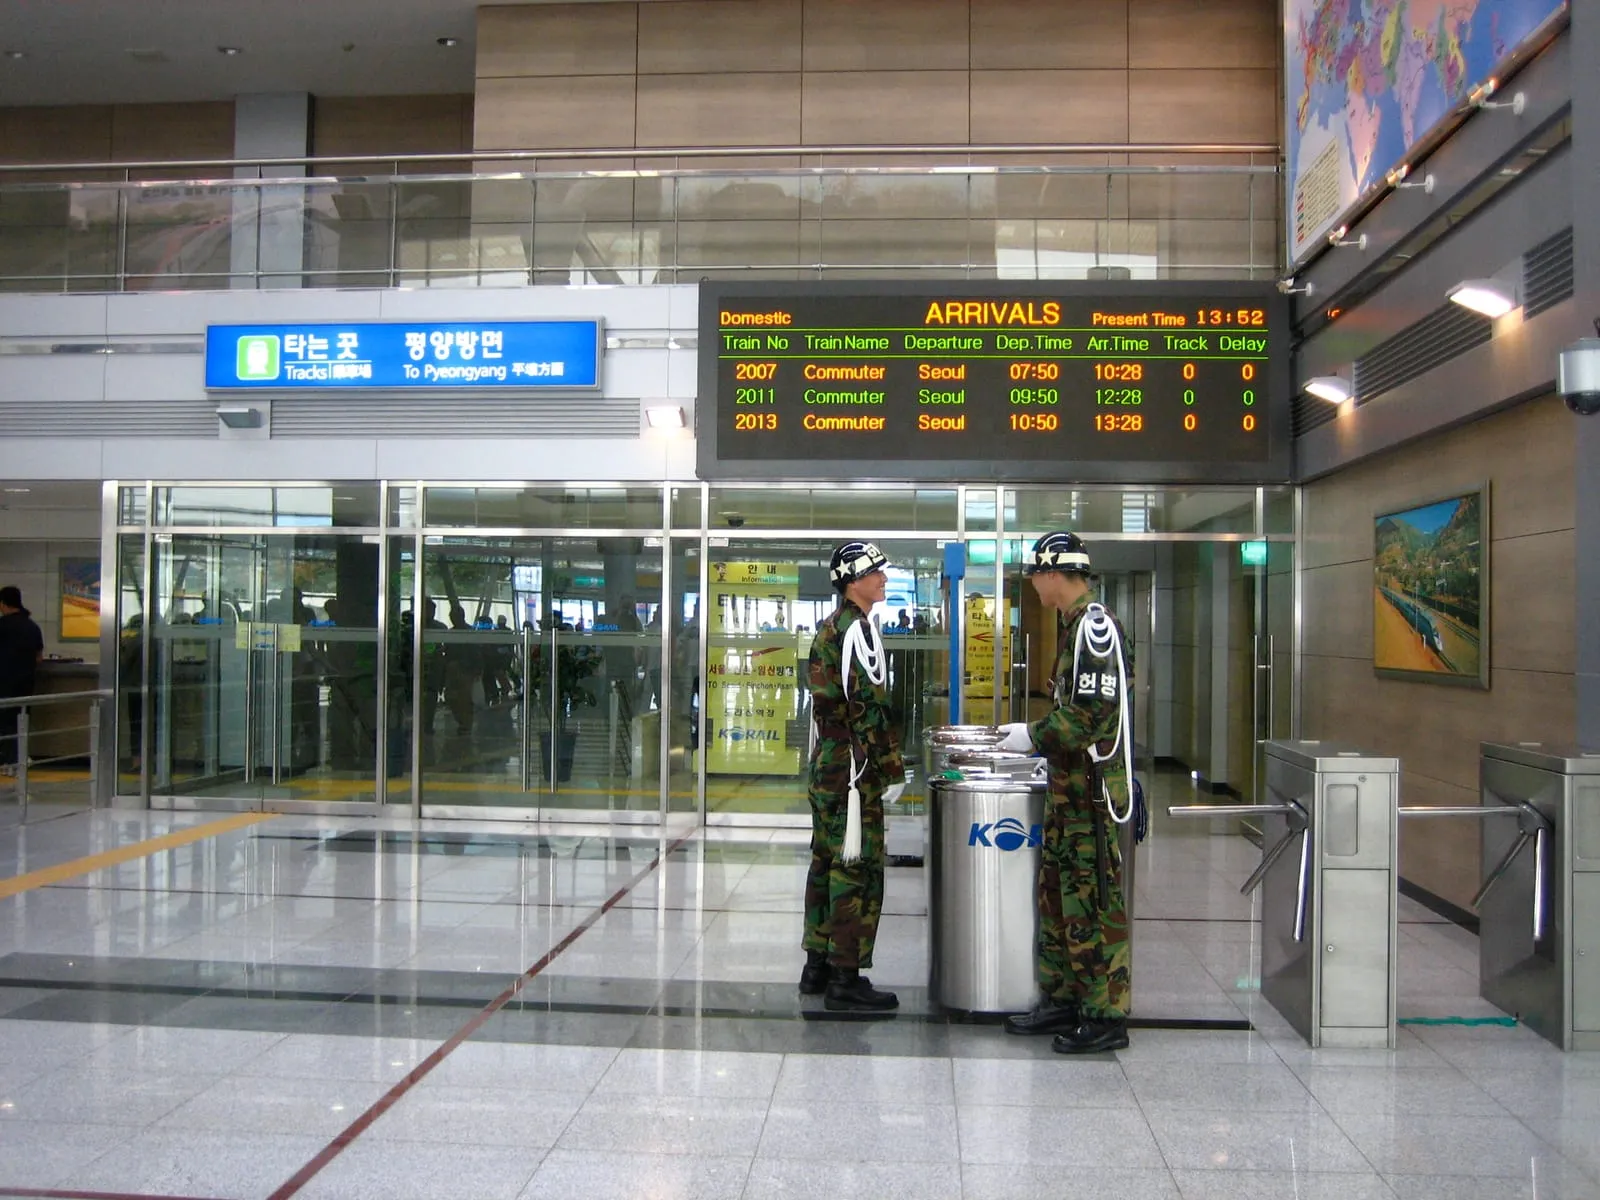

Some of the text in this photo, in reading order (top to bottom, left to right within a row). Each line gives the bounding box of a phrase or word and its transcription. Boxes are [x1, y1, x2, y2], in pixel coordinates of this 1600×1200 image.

[721, 312, 791, 325] Domestic
[925, 302, 1060, 325] ARRIVALS
[1093, 310, 1264, 326] Present Time 13:52
[284, 332, 358, 360] 타는 곳
[405, 331, 503, 361] 평양방면
[723, 336, 788, 349] Train No
[905, 335, 982, 351] Departure
[997, 335, 1072, 351] Dep.Time
[1088, 336, 1149, 350] Arr.Time
[1164, 336, 1208, 350] Track
[1220, 336, 1266, 353] Delay
[284, 365, 327, 380] Tracks
[403, 364, 506, 382] To Pyeongyang
[735, 363, 777, 380] 2007
[804, 363, 885, 380] Commuter
[919, 363, 965, 380] Seoul
[1010, 363, 1058, 380] 07:50
[1095, 363, 1142, 380] 10:28
[1183, 363, 1195, 380] 0
[1242, 364, 1255, 381] 0
[735, 389, 774, 404] 2011
[804, 389, 885, 404] Commuter
[919, 389, 965, 404] Seoul
[1010, 389, 1058, 404] 09:50
[1095, 389, 1142, 404] 12:28
[1183, 389, 1195, 404] 0
[1242, 390, 1255, 405] 0
[735, 414, 777, 430] 2013
[804, 414, 885, 430] Commuter
[919, 414, 965, 430] Seoul
[1010, 414, 1058, 430] 10:50
[1095, 414, 1142, 430] 13:28
[1183, 414, 1195, 431] 0
[1242, 415, 1255, 431] 0
[1078, 672, 1117, 697] 헌병
[718, 726, 780, 741] KORAIL
